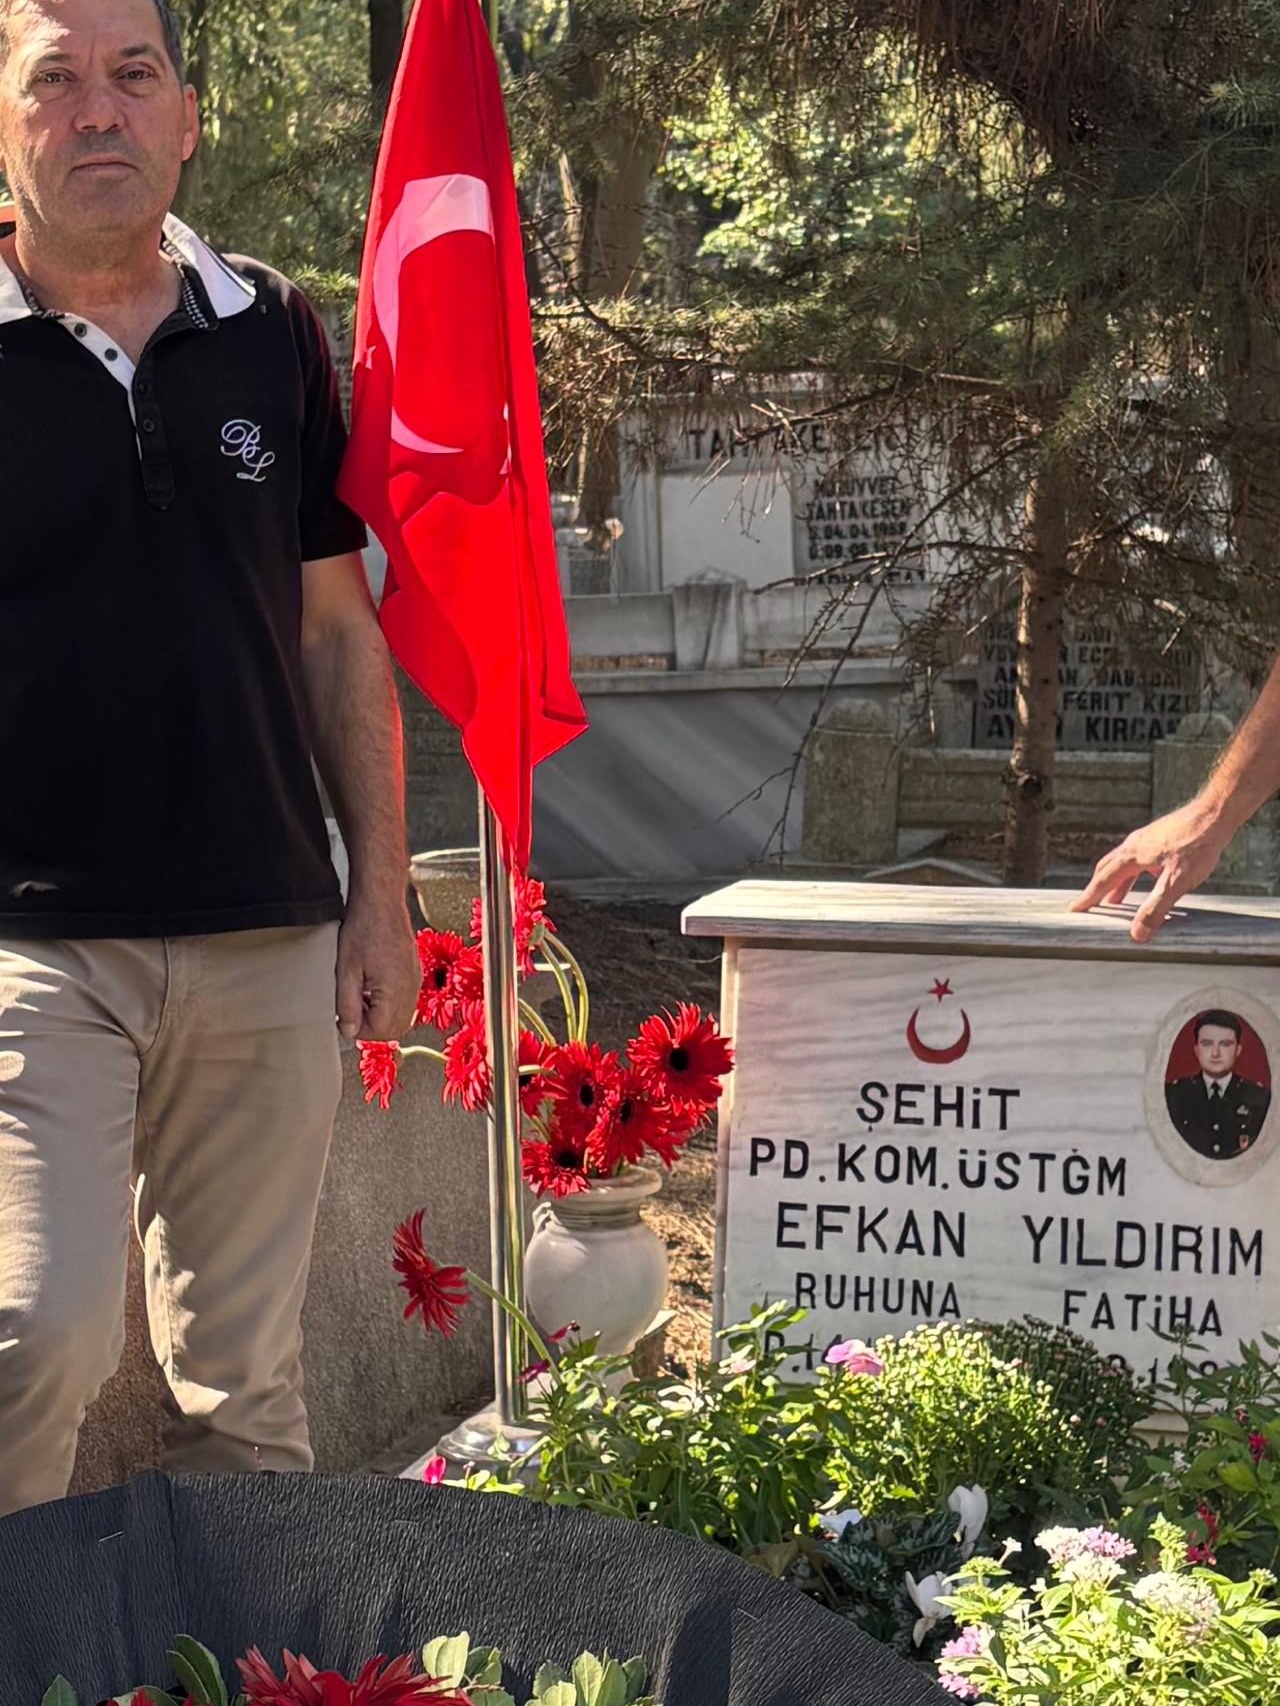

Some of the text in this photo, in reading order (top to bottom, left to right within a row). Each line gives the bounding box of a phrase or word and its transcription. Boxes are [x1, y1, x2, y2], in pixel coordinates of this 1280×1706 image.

[776, 1201, 1263, 1276] EFKAN YILDIRIM
[795, 1272, 961, 1320] RUHUNA
